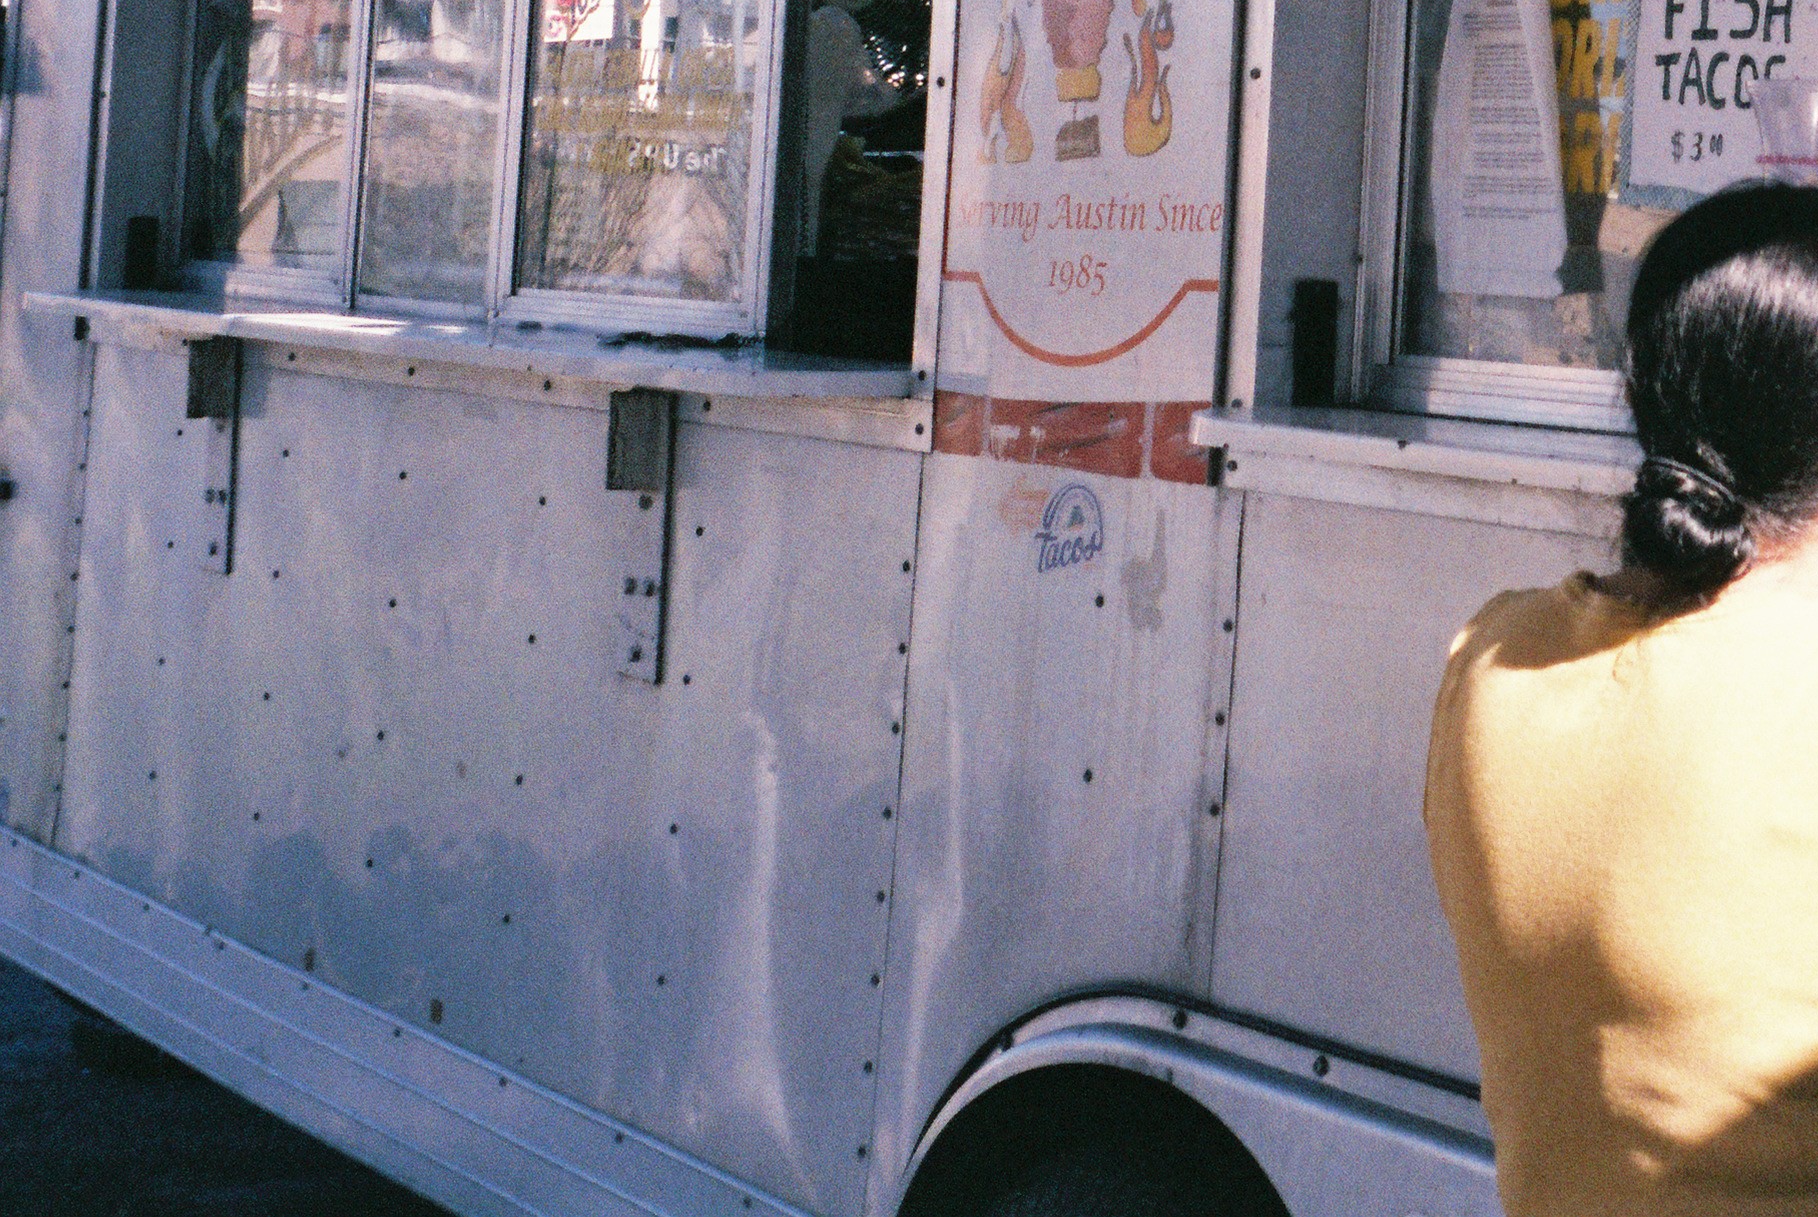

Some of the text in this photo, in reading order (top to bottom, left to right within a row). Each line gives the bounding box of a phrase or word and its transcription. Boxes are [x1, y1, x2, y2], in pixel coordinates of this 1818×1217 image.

[1046, 191, 1148, 233] Austin
[1153, 191, 1226, 233] Since
[1048, 252, 1109, 298] 1985
[1033, 529, 1104, 575] Tacos
